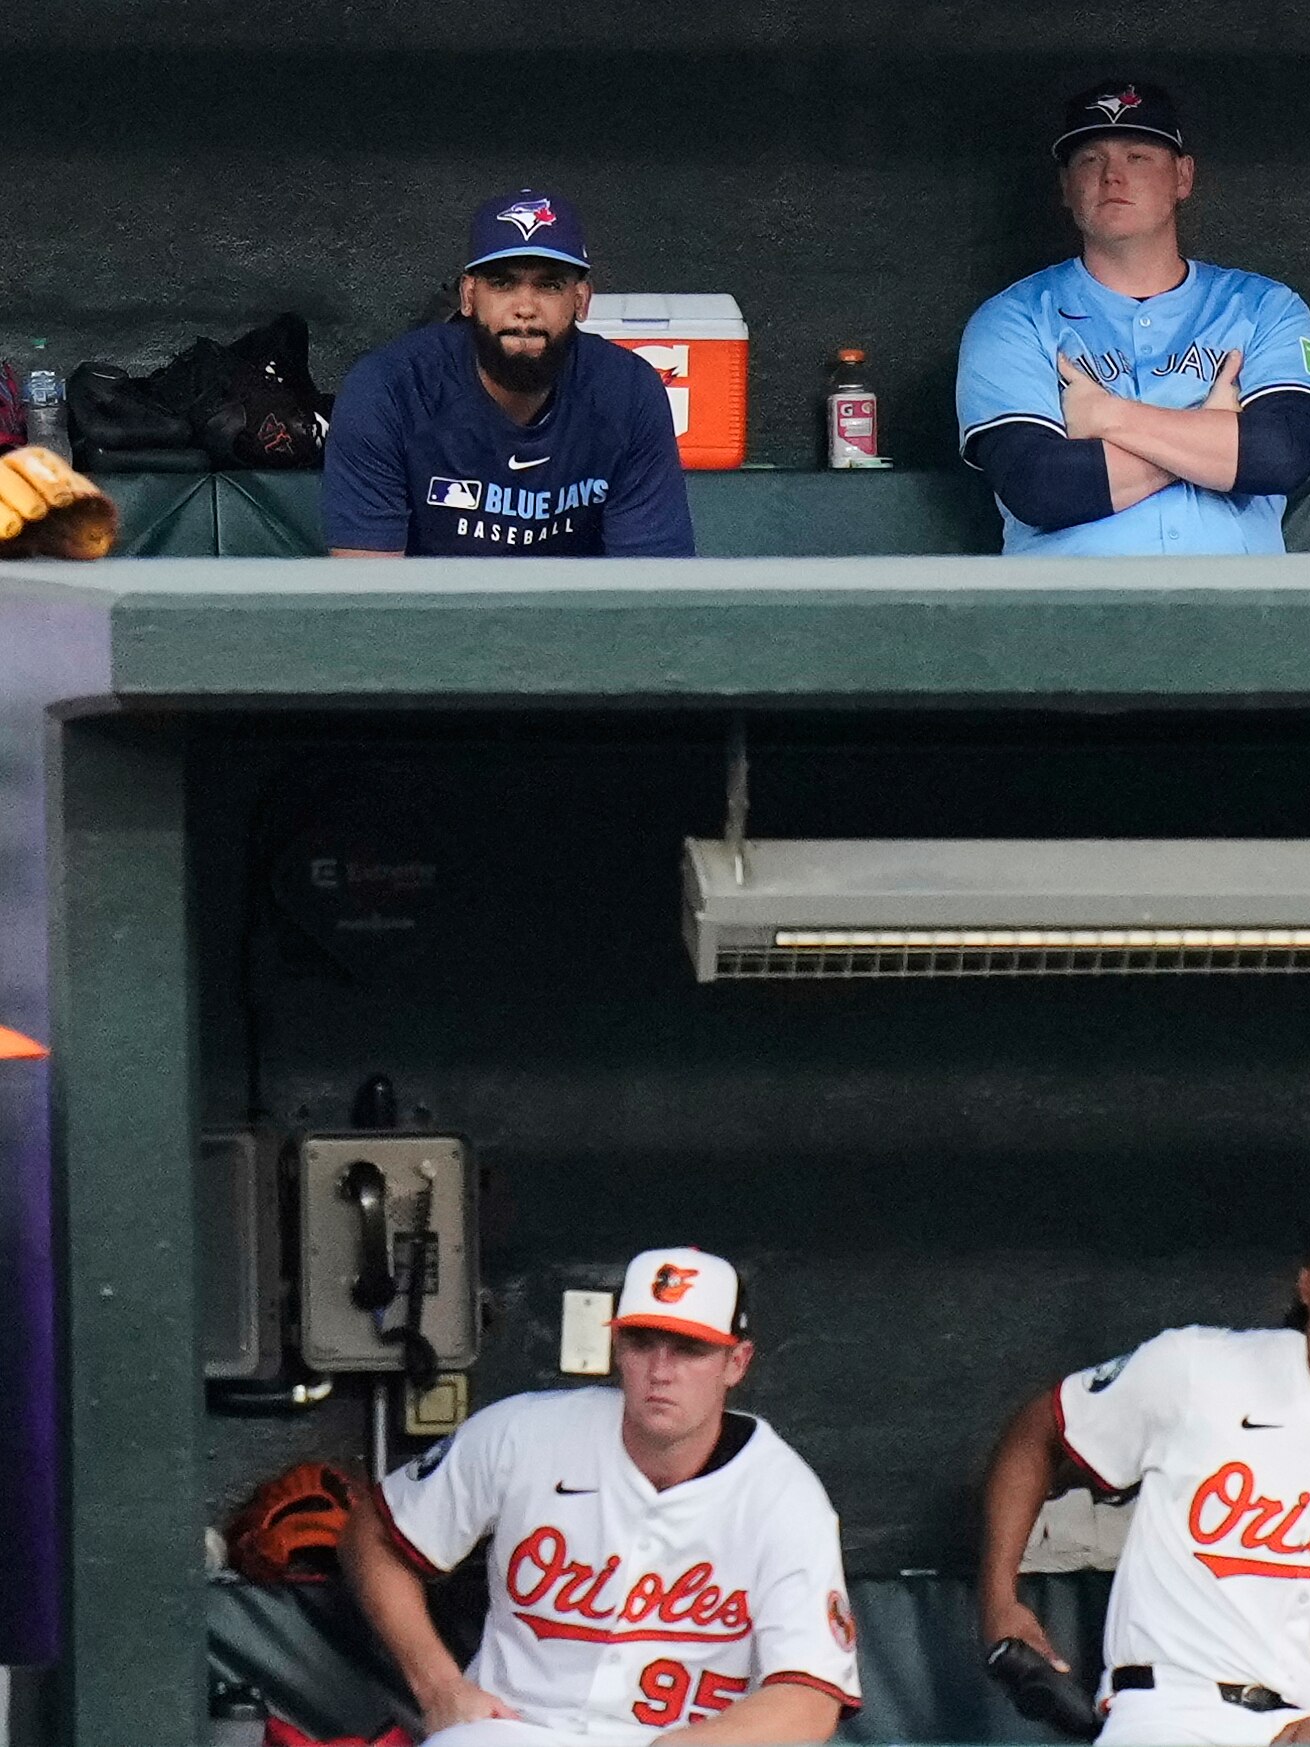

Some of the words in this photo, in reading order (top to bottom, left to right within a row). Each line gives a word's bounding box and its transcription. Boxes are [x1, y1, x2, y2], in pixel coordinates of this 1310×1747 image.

[1150, 340, 1229, 383] JAY
[484, 482, 552, 520] BLUE
[554, 477, 610, 515] JAYS
[457, 517, 574, 545] BASEBALL
[506, 1525, 752, 1630] Orioles
